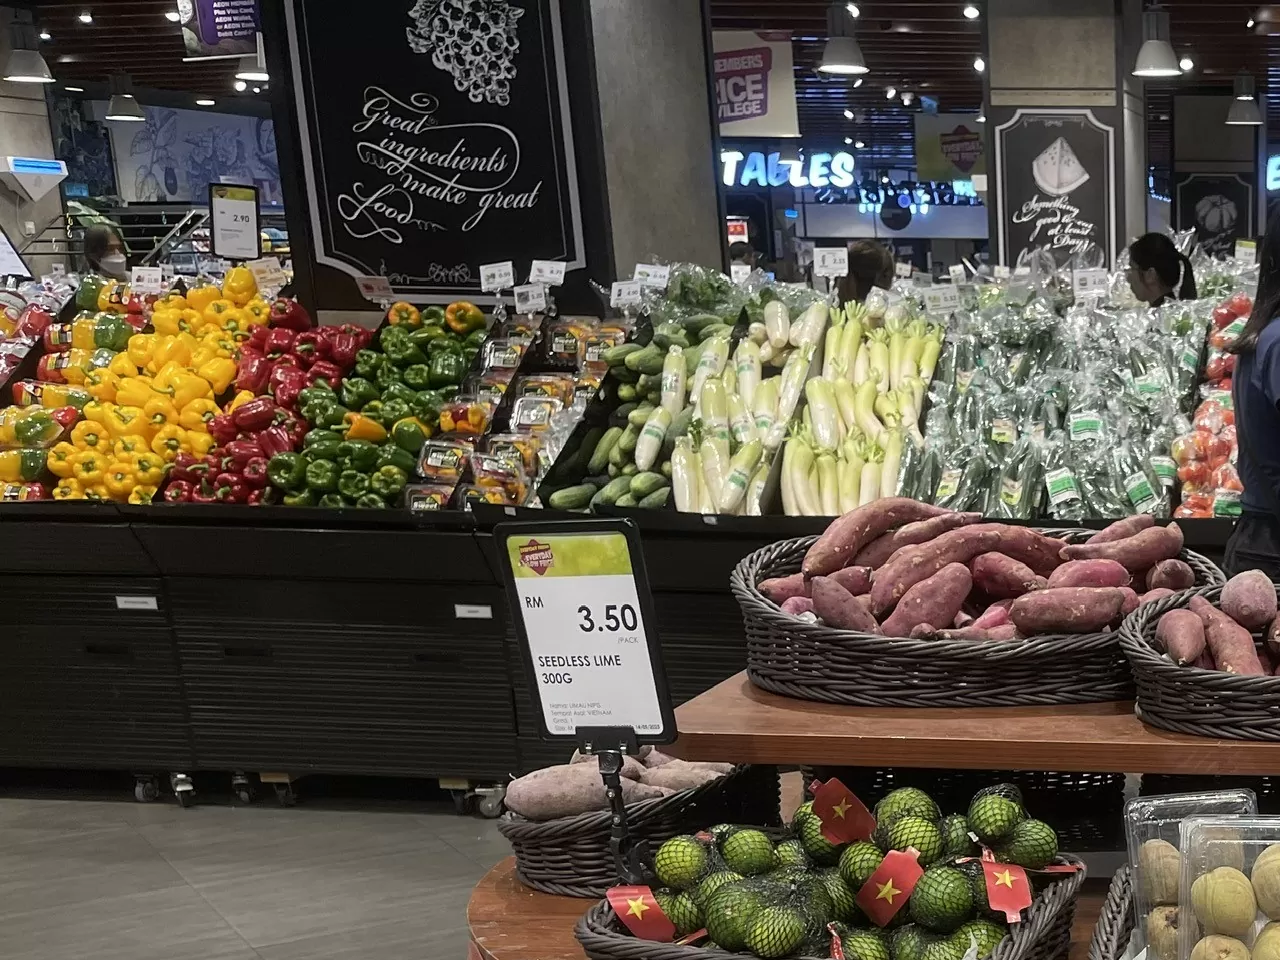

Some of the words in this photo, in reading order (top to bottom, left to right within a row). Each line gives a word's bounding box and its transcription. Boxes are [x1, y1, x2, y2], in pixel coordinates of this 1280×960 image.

[378, 132, 508, 174] ingredients
[400, 173, 467, 205] make
[462, 180, 543, 232] great
[233, 214, 250, 222] 2.90
[525, 597, 544, 608] RM
[577, 604, 638, 632] 3.50
[538, 655, 590, 667] SEEDLESS
[594, 655, 621, 666] LIME
[542, 673, 572, 684] 300G
